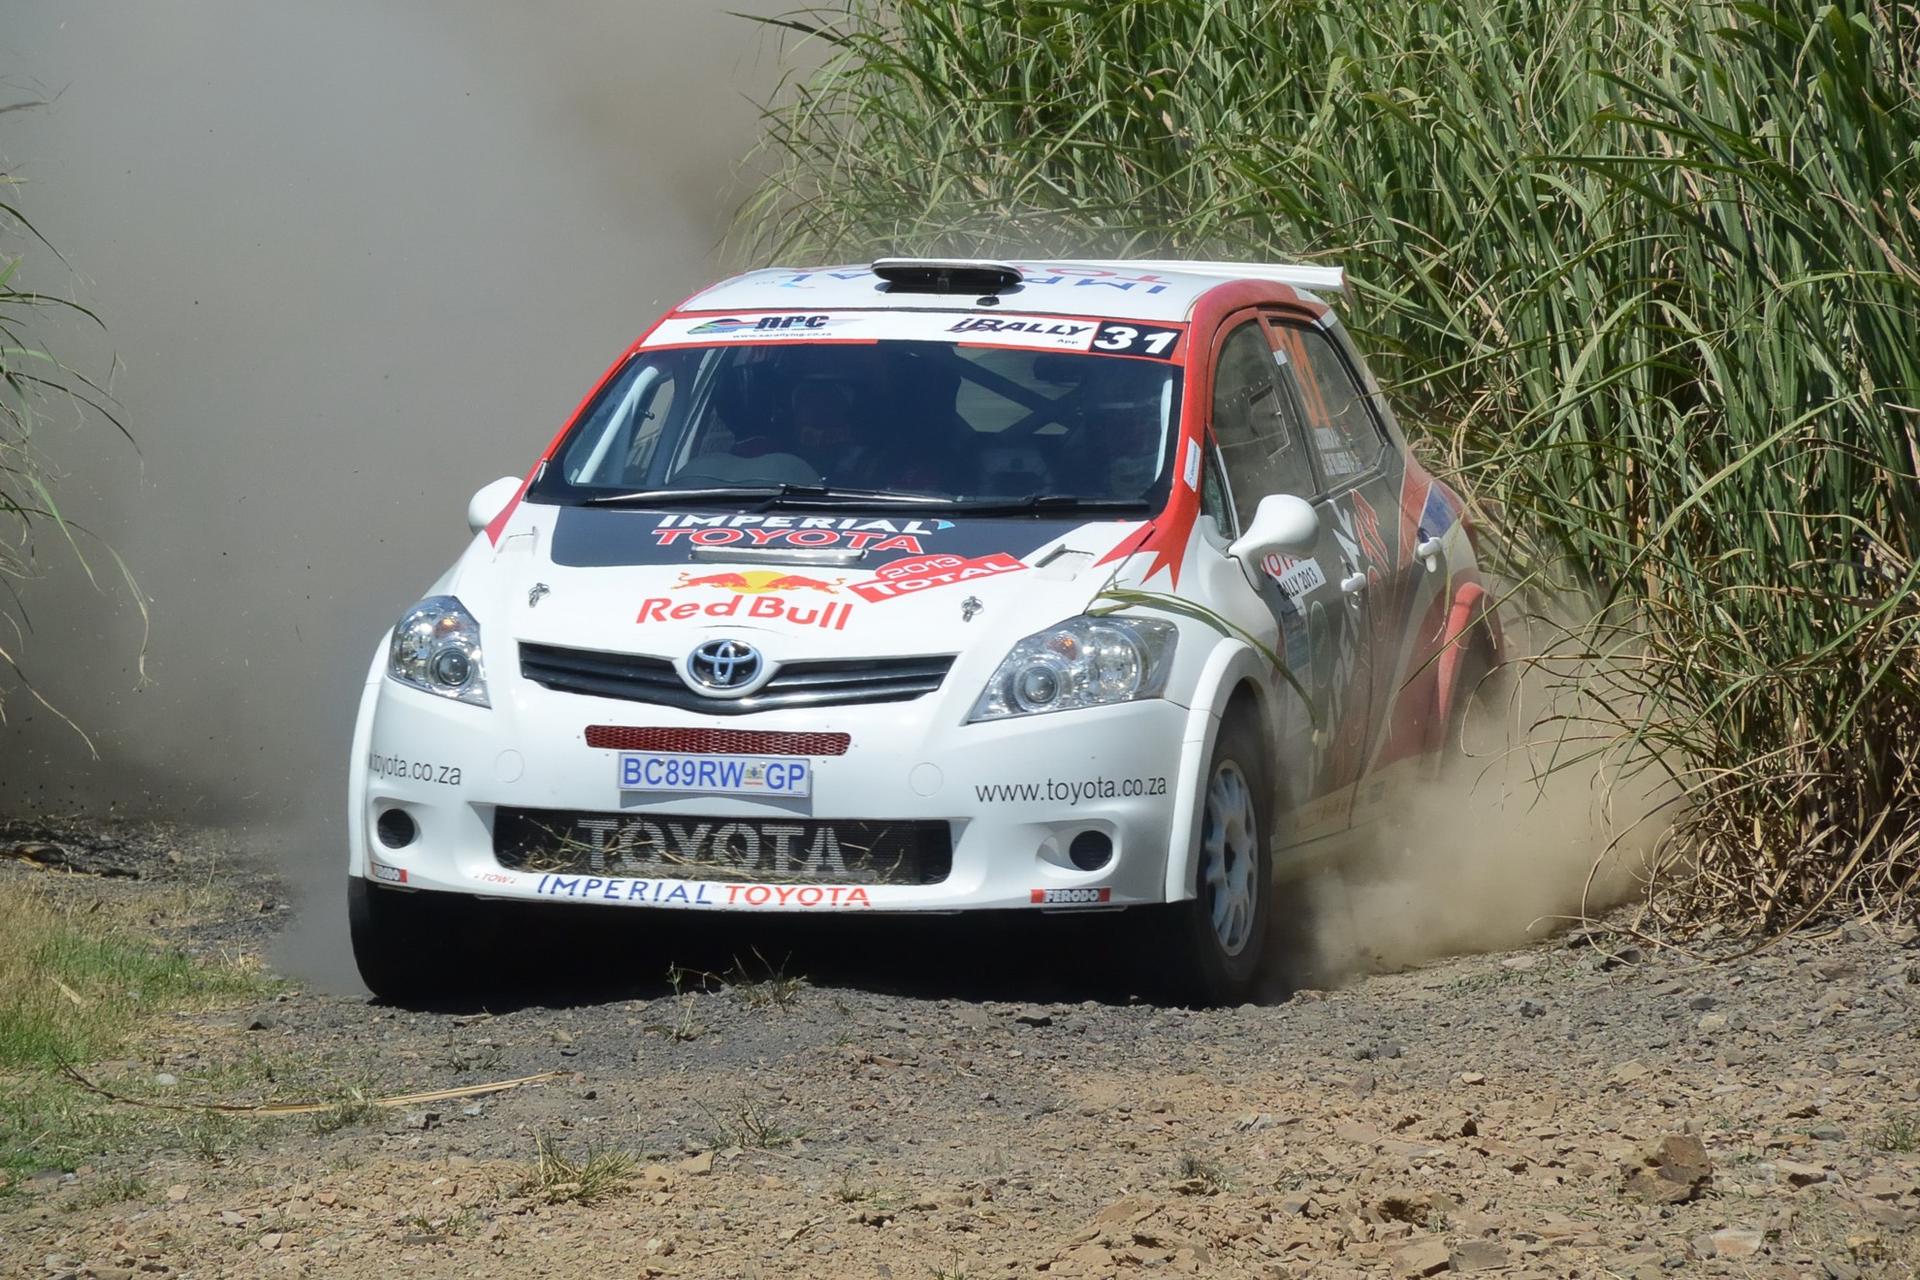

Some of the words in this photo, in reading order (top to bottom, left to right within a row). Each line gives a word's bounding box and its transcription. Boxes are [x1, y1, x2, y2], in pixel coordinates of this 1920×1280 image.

[1093, 326, 1178, 354] 31
[657, 514, 933, 535] IMPERIAL
[651, 528, 924, 554] TOYOTA
[858, 560, 1021, 595] TOTAL
[888, 557, 962, 579] 2013
[1297, 568, 1318, 595] 2013
[636, 595, 743, 623] Red
[748, 597, 853, 630] Bull
[623, 758, 746, 788] BC89RW
[765, 763, 805, 791] GP
[975, 776, 1167, 805] www.toyota.co.za
[577, 817, 849, 876] TOYOTA
[537, 874, 713, 904] IMPERIAL
[725, 884, 871, 907] TOYOTA
[1044, 889, 1100, 903] FERODO
